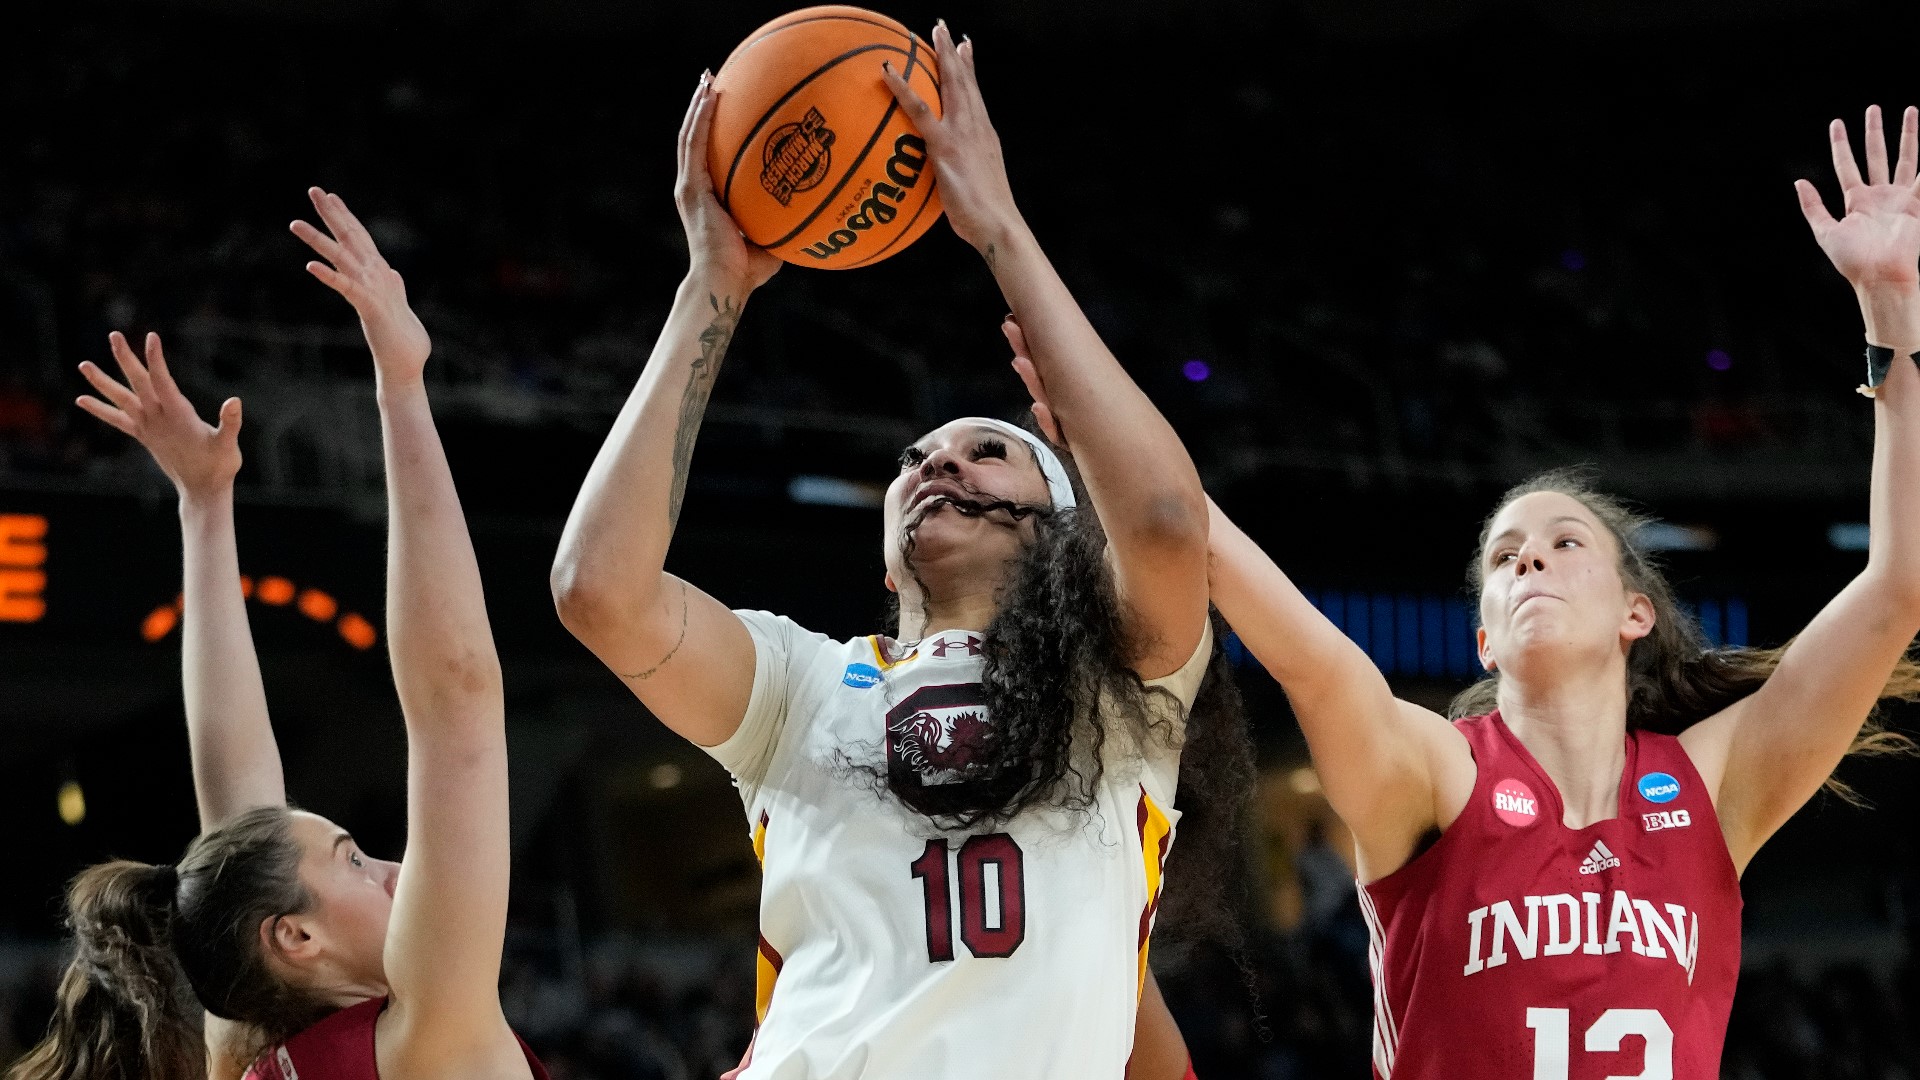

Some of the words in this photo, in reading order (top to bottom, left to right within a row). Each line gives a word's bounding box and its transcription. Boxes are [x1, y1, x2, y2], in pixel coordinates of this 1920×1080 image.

[761, 133, 809, 194] MADNESS
[784, 138, 825, 187] MARCH
[800, 133, 928, 260] Wilson
[853, 178, 872, 202] EVO
[836, 203, 856, 223] NXT
[1495, 792, 1536, 816] RMK
[1645, 783, 1679, 797] NCAA
[1579, 856, 1621, 875] adidas
[910, 832, 1026, 963] 10
[1463, 890, 1699, 988] INDIANA
